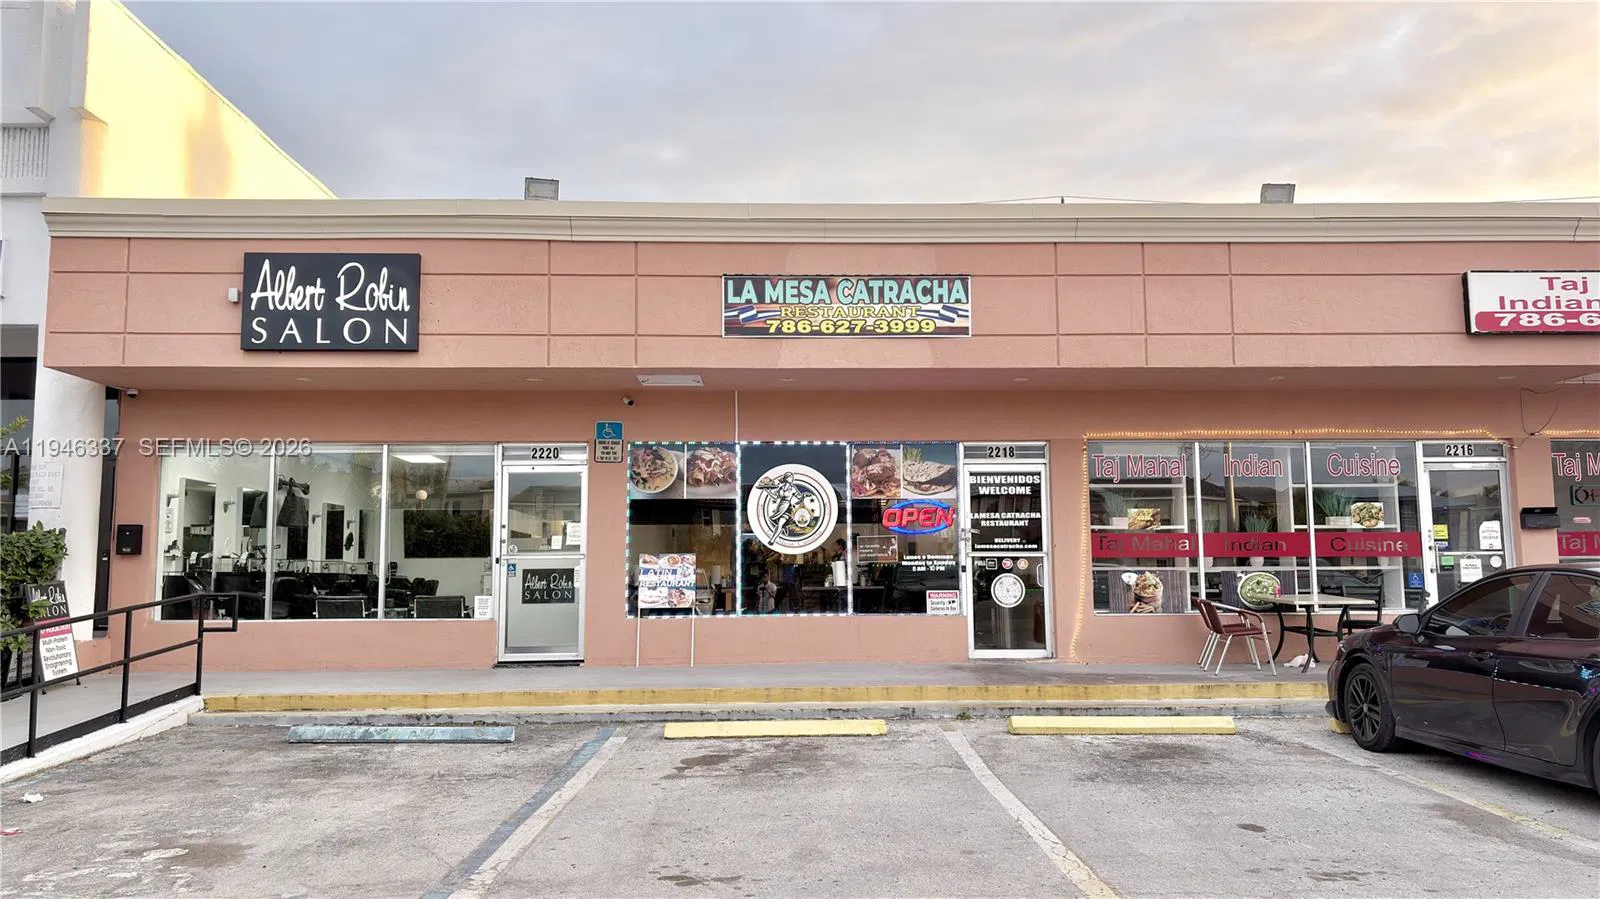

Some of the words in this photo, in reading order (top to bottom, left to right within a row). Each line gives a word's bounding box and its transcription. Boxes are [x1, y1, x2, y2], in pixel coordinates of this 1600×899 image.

[251, 258, 325, 311] Albert
[335, 261, 410, 311] Robin
[727, 279, 758, 304] LA
[764, 279, 831, 304] MESA
[836, 278, 968, 304] CATRACHA
[1540, 276, 1588, 294] Taj
[1499, 295, 1600, 310] Indian
[779, 306, 921, 318] RESTAURANT
[1494, 312, 1600, 327] 786-6
[251, 317, 408, 344] SALON
[765, 319, 936, 334] 786-627-3999
[531, 447, 559, 459] 2220
[988, 446, 1015, 458] 2218
[1445, 444, 1473, 456] 2216
[1092, 454, 1120, 483] Taj
[1125, 453, 1186, 478] Mahal
[1223, 453, 1283, 478] Indian
[1326, 452, 1401, 478] Cuisine
[1551, 452, 1582, 482] Taj
[969, 475, 1041, 484] BIENVENIDOS
[978, 486, 1032, 495] WELCOME
[882, 507, 955, 528] OPEN
[981, 519, 1029, 527] RESTAURANT
[1095, 536, 1123, 553] Taj
[1132, 536, 1195, 551] Mahal
[1224, 537, 1287, 552] Indian
[1330, 537, 1408, 552] Cuisine
[1558, 535, 1587, 553] Taj
[640, 568, 672, 576] LATIN
[525, 572, 547, 590] Albert
[549, 573, 573, 590] Robin
[525, 590, 572, 600] SALON
